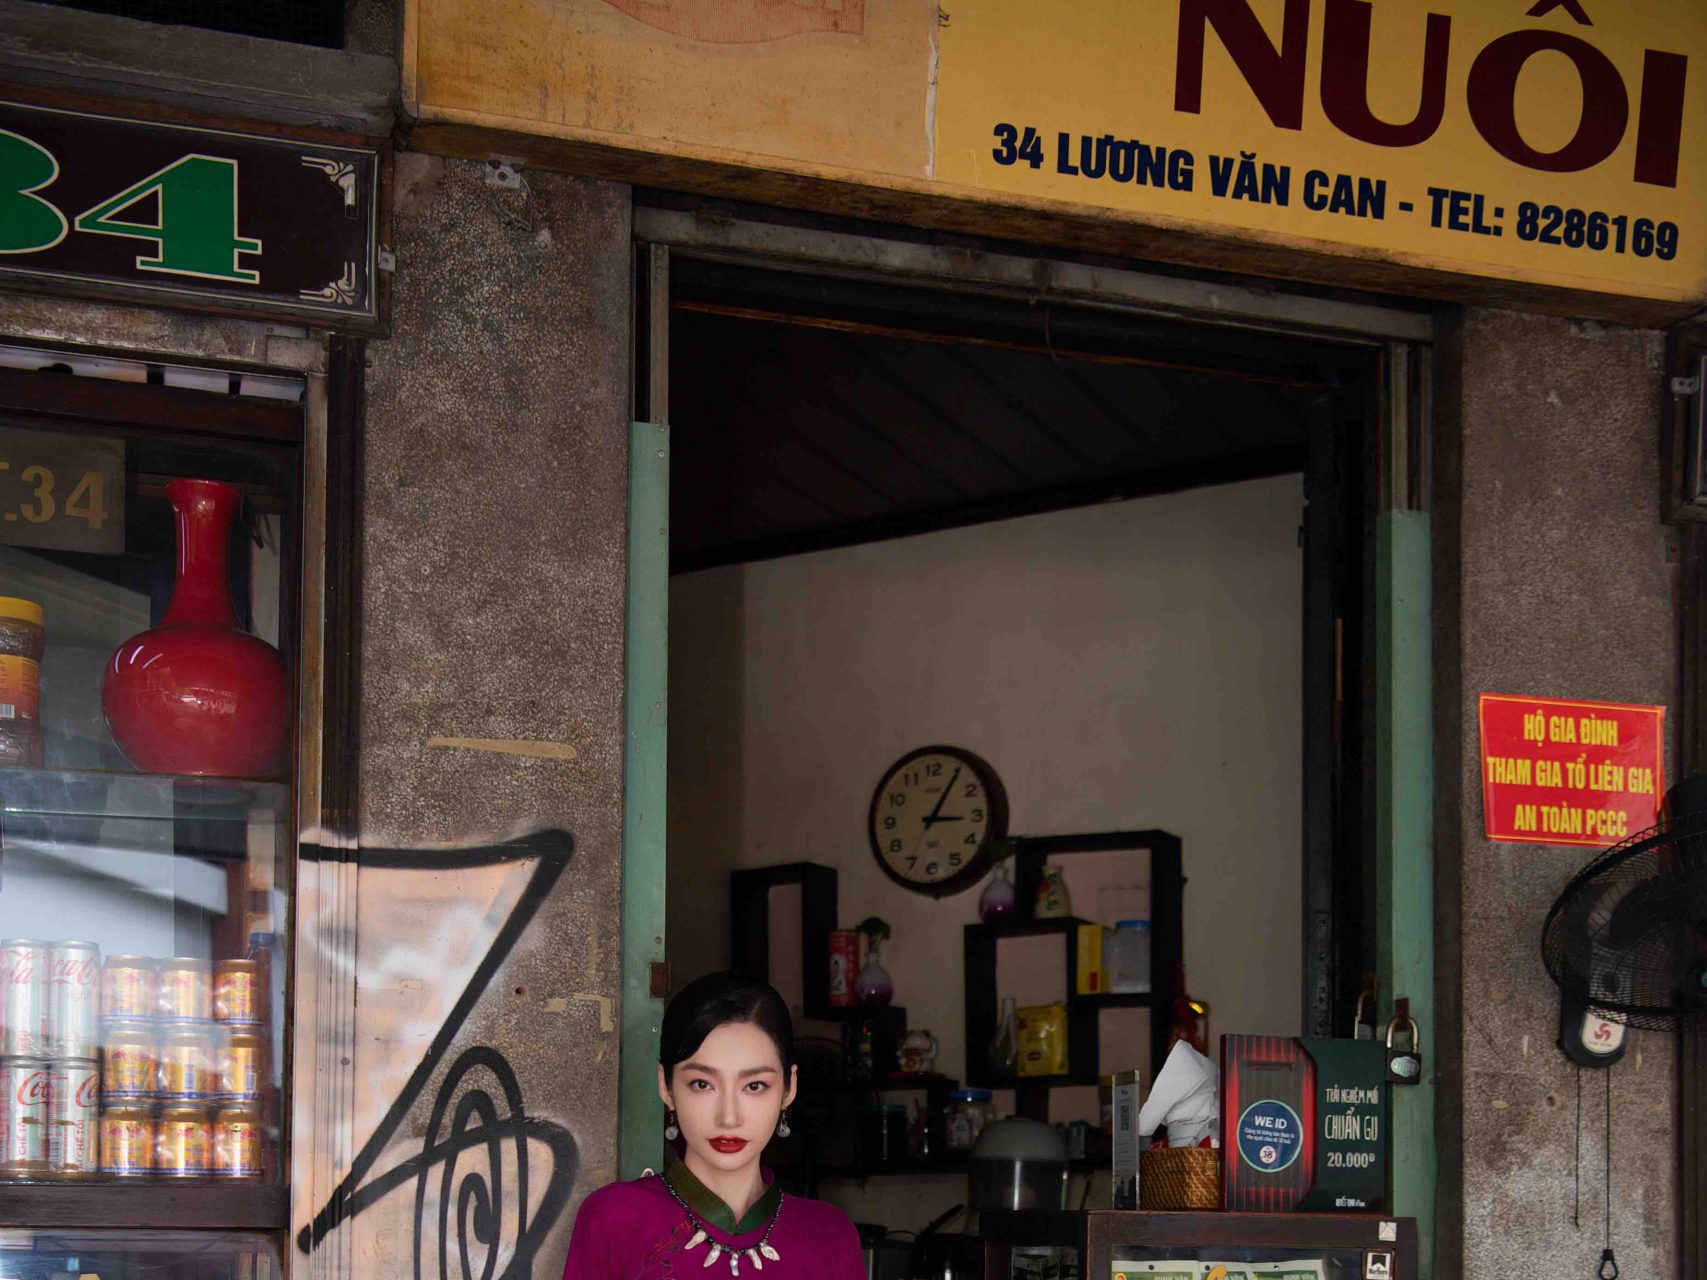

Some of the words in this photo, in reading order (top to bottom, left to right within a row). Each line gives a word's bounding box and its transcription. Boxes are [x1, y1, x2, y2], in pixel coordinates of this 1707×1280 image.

[1174, 0, 1688, 188] NUÔI
[992, 123, 1044, 170] 34
[1056, 132, 1195, 192] LƯƠNG
[1208, 151, 1291, 207] VĂN
[1303, 170, 1387, 220] CAN
[1427, 187, 1505, 237] TEL:
[1516, 201, 1679, 261] 8286169
[0, 460, 109, 530] .34
[1523, 709, 1546, 747] HỘ
[1549, 715, 1577, 744] GIA
[1579, 713, 1619, 747] ĐÌNH
[925, 763, 942, 777] 12
[1486, 756, 1532, 785] THAM
[1535, 760, 1563, 788] GIA
[1565, 753, 1586, 790] TỔ
[1589, 760, 1625, 793] LIÊN
[1627, 767, 1654, 795] GIA
[904, 773, 919, 787] 11
[964, 784, 977, 798] 2
[889, 793, 906, 808] 10
[884, 816, 897, 830] 9
[971, 809, 983, 823] 3
[1513, 804, 1537, 832] AN
[1540, 802, 1583, 834] TOÀN
[1585, 808, 1628, 837] PCCC
[889, 838, 902, 853] 8
[964, 832, 977, 844] 4
[904, 855, 917, 870] 7
[949, 852, 961, 866] 5
[926, 862, 938, 876] 6
[1254, 1115, 1274, 1128] WE
[1274, 1117, 1288, 1129] ID
[1363, 1115, 1378, 1141] GU
